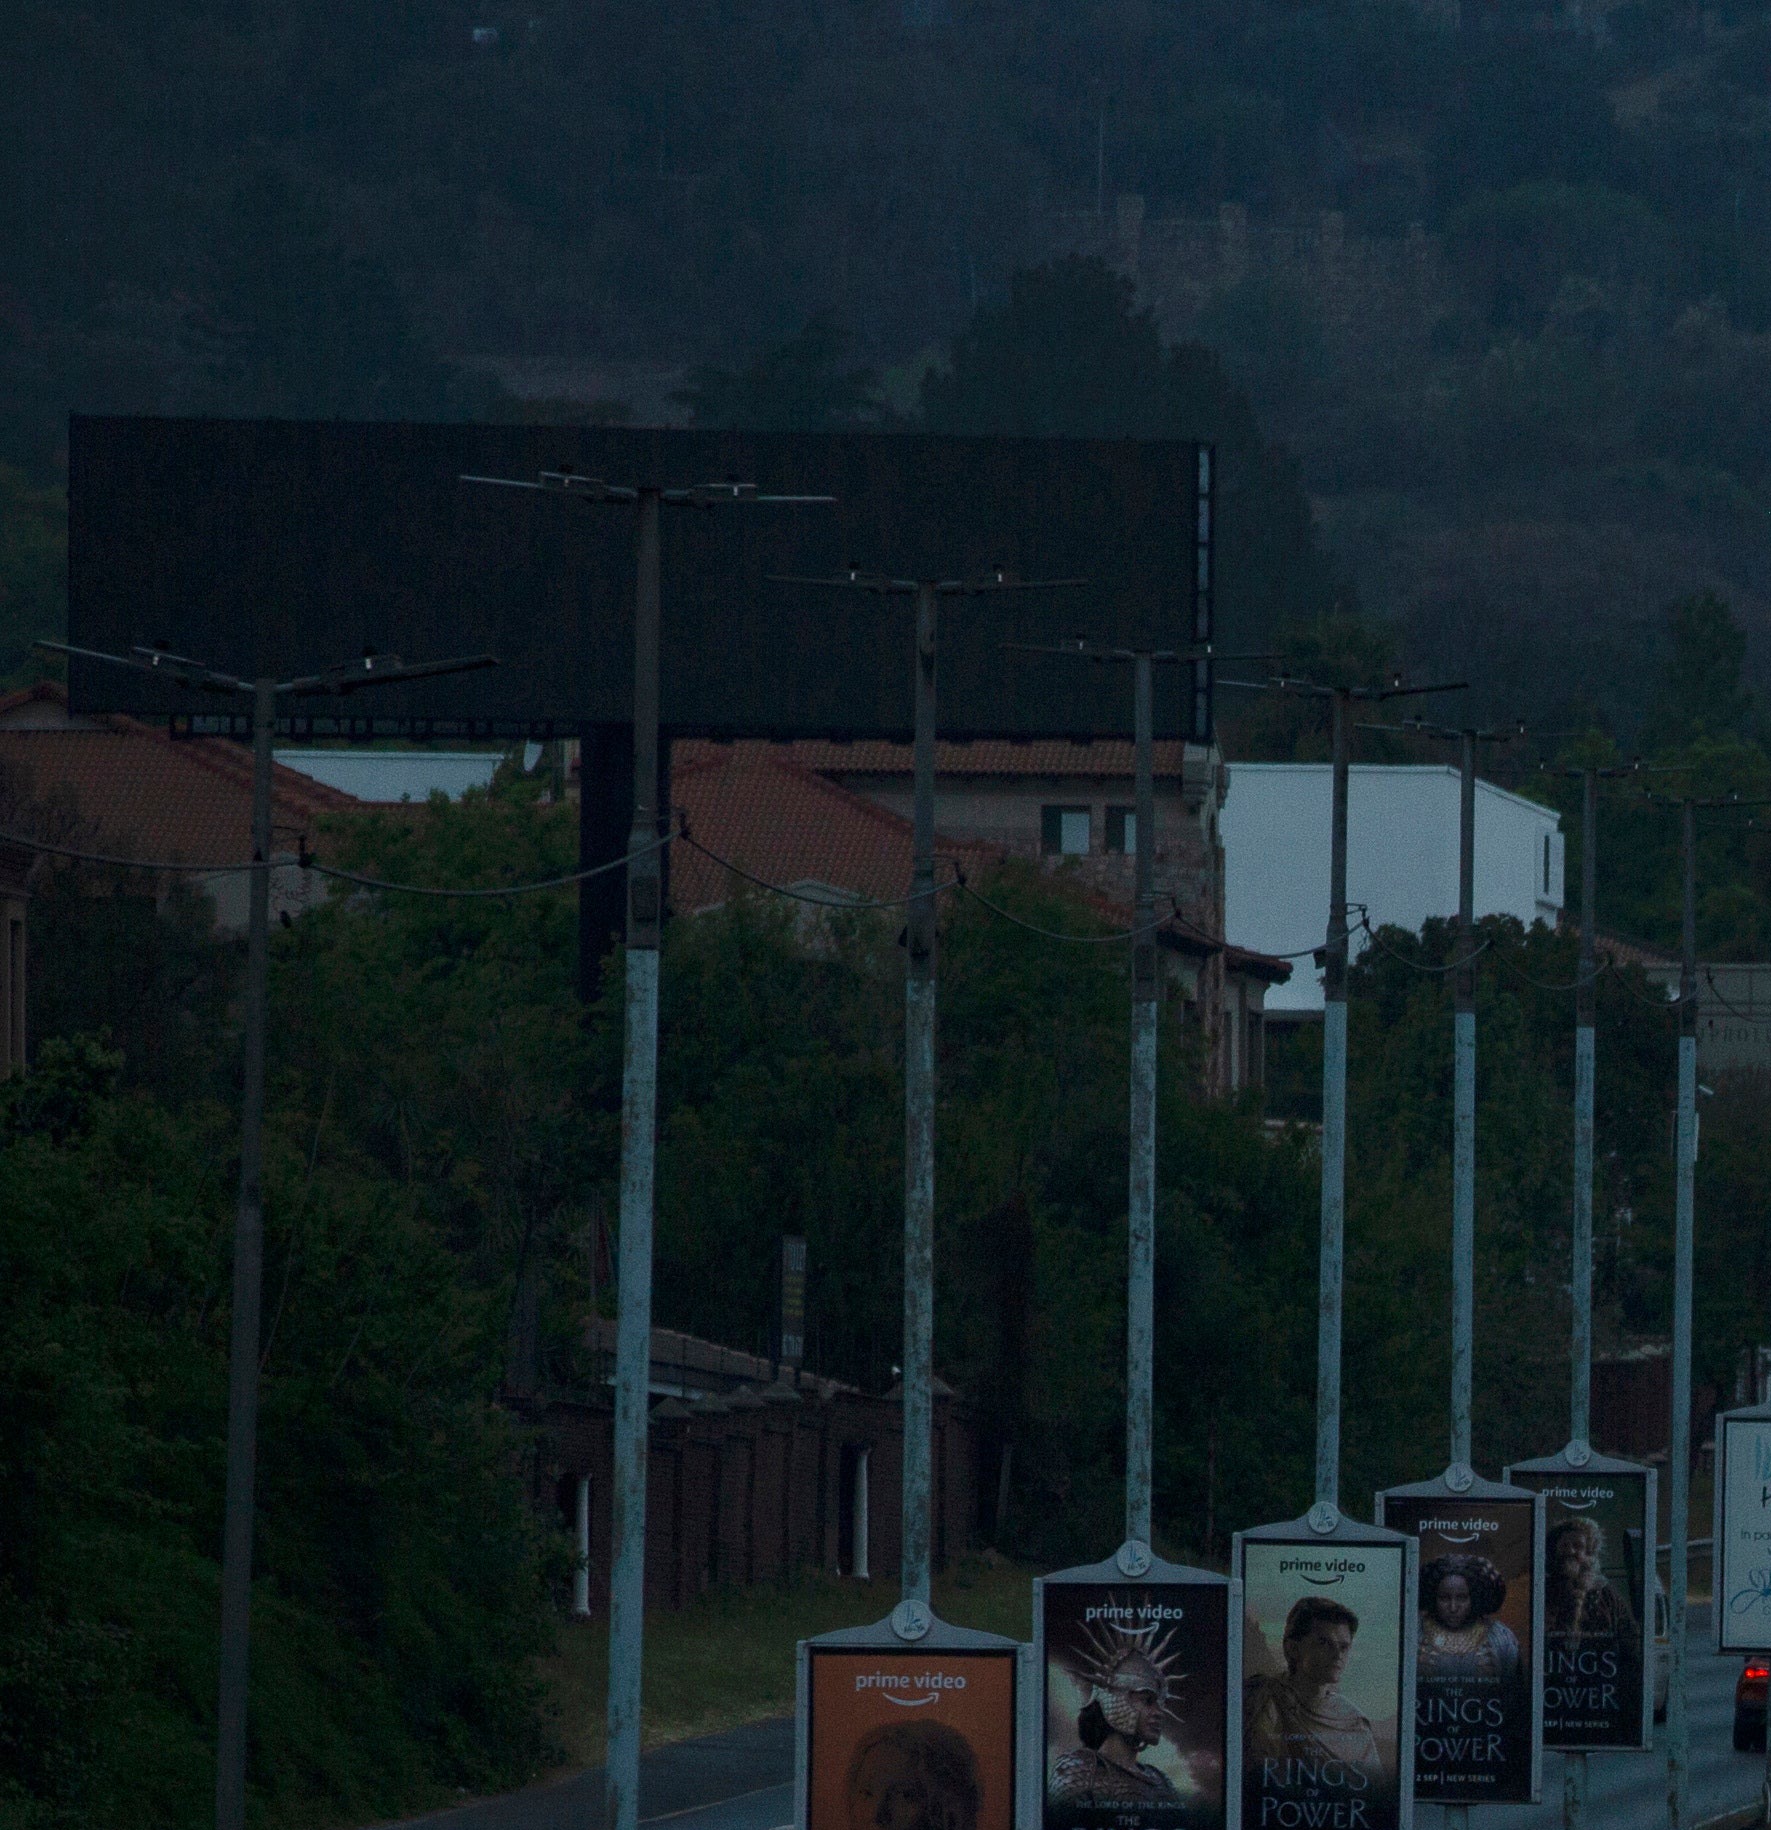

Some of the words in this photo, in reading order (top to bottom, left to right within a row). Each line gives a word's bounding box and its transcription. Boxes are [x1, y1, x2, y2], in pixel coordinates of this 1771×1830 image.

[1541, 1486, 1578, 1499] prime
[1580, 1486, 1615, 1499] video
[1418, 1517, 1459, 1533] prime
[1461, 1517, 1500, 1532] video
[1280, 1557, 1322, 1573] prime
[1325, 1558, 1366, 1573] video
[1085, 1603, 1134, 1623] prime
[1136, 1603, 1184, 1620] video
[1544, 1650, 1618, 1678] INGS
[855, 1670, 910, 1692] prime
[913, 1671, 967, 1690] video
[1564, 1720, 1583, 1728] NEW
[1584, 1720, 1610, 1729] SERIES
[1262, 1758, 1368, 1791] RINGS
[1416, 1774, 1422, 1782] 2
[1423, 1774, 1439, 1782] SEP
[1446, 1774, 1466, 1783] NEW
[1467, 1774, 1496, 1783] SERIES
[1117, 1814, 1141, 1827] THE
[1261, 1796, 1371, 1829] POWER
